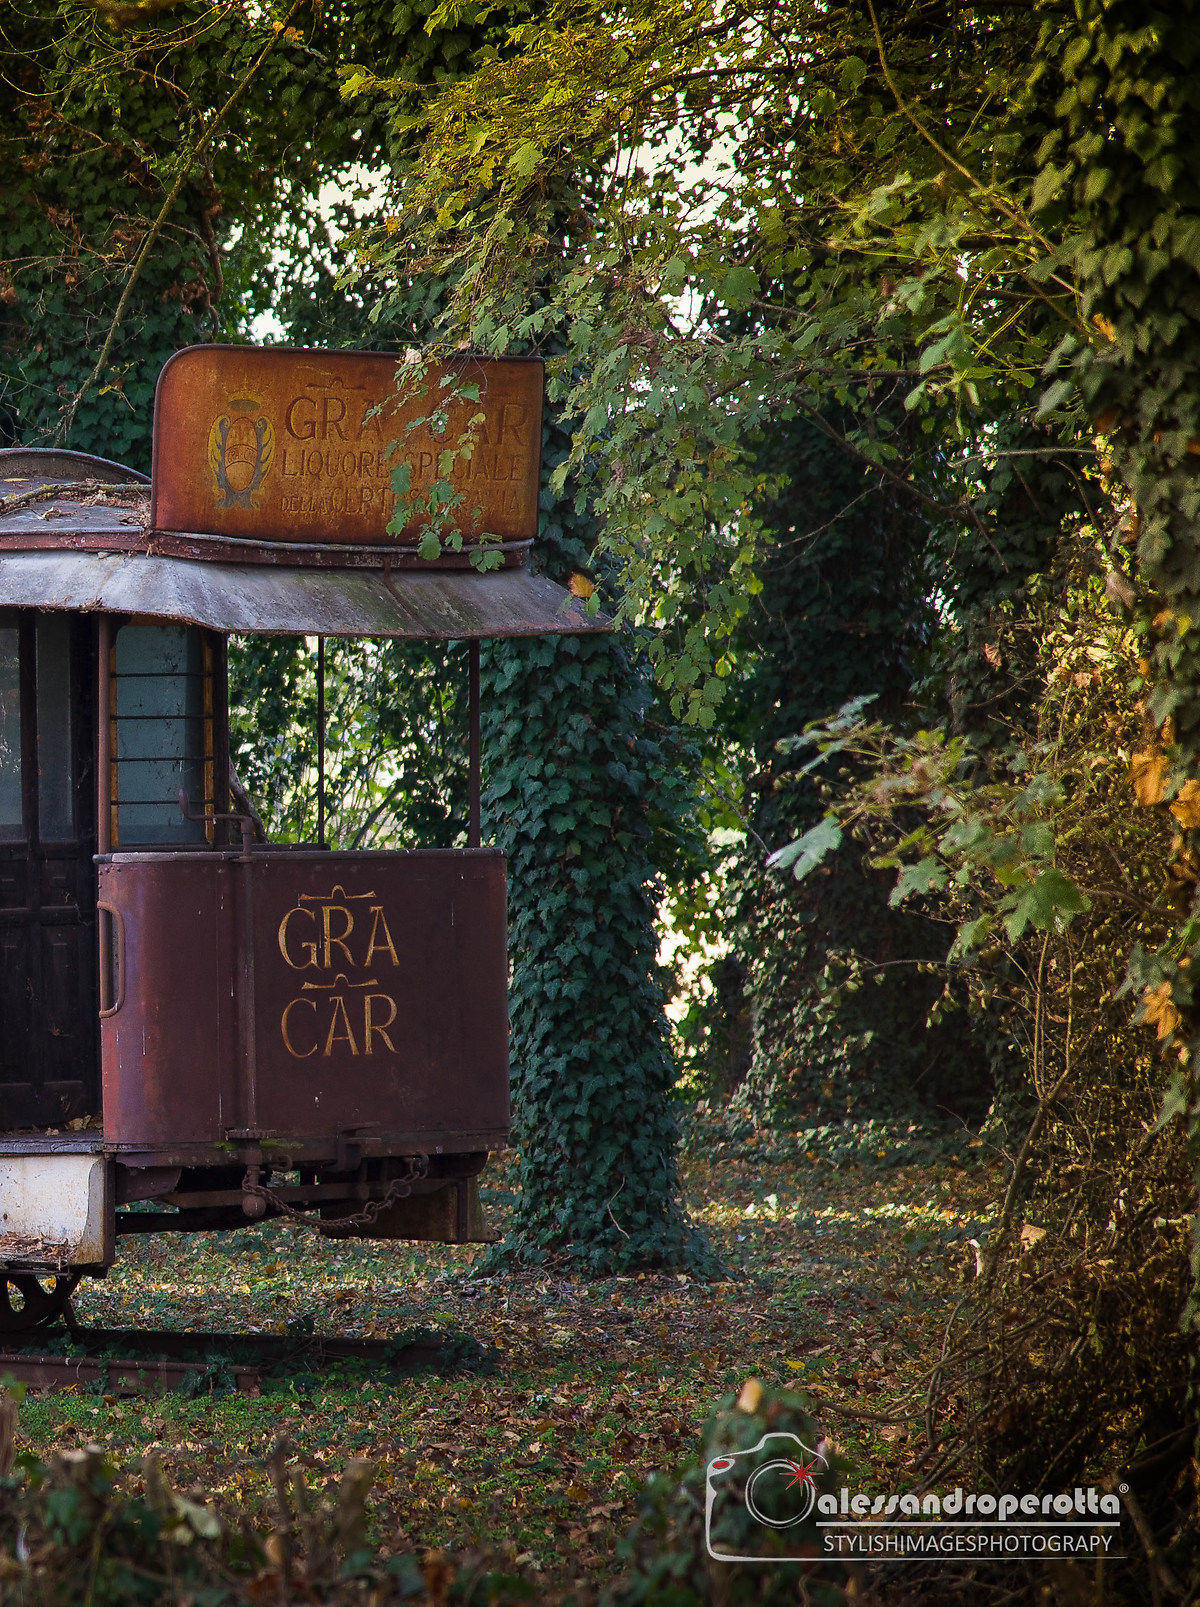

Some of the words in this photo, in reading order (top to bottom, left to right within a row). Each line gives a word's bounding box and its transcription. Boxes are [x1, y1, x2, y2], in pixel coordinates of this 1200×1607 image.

[285, 395, 384, 443] GRA
[280, 448, 390, 482] LIQUORE
[278, 905, 400, 970] GRA
[281, 994, 400, 1058] CAR
